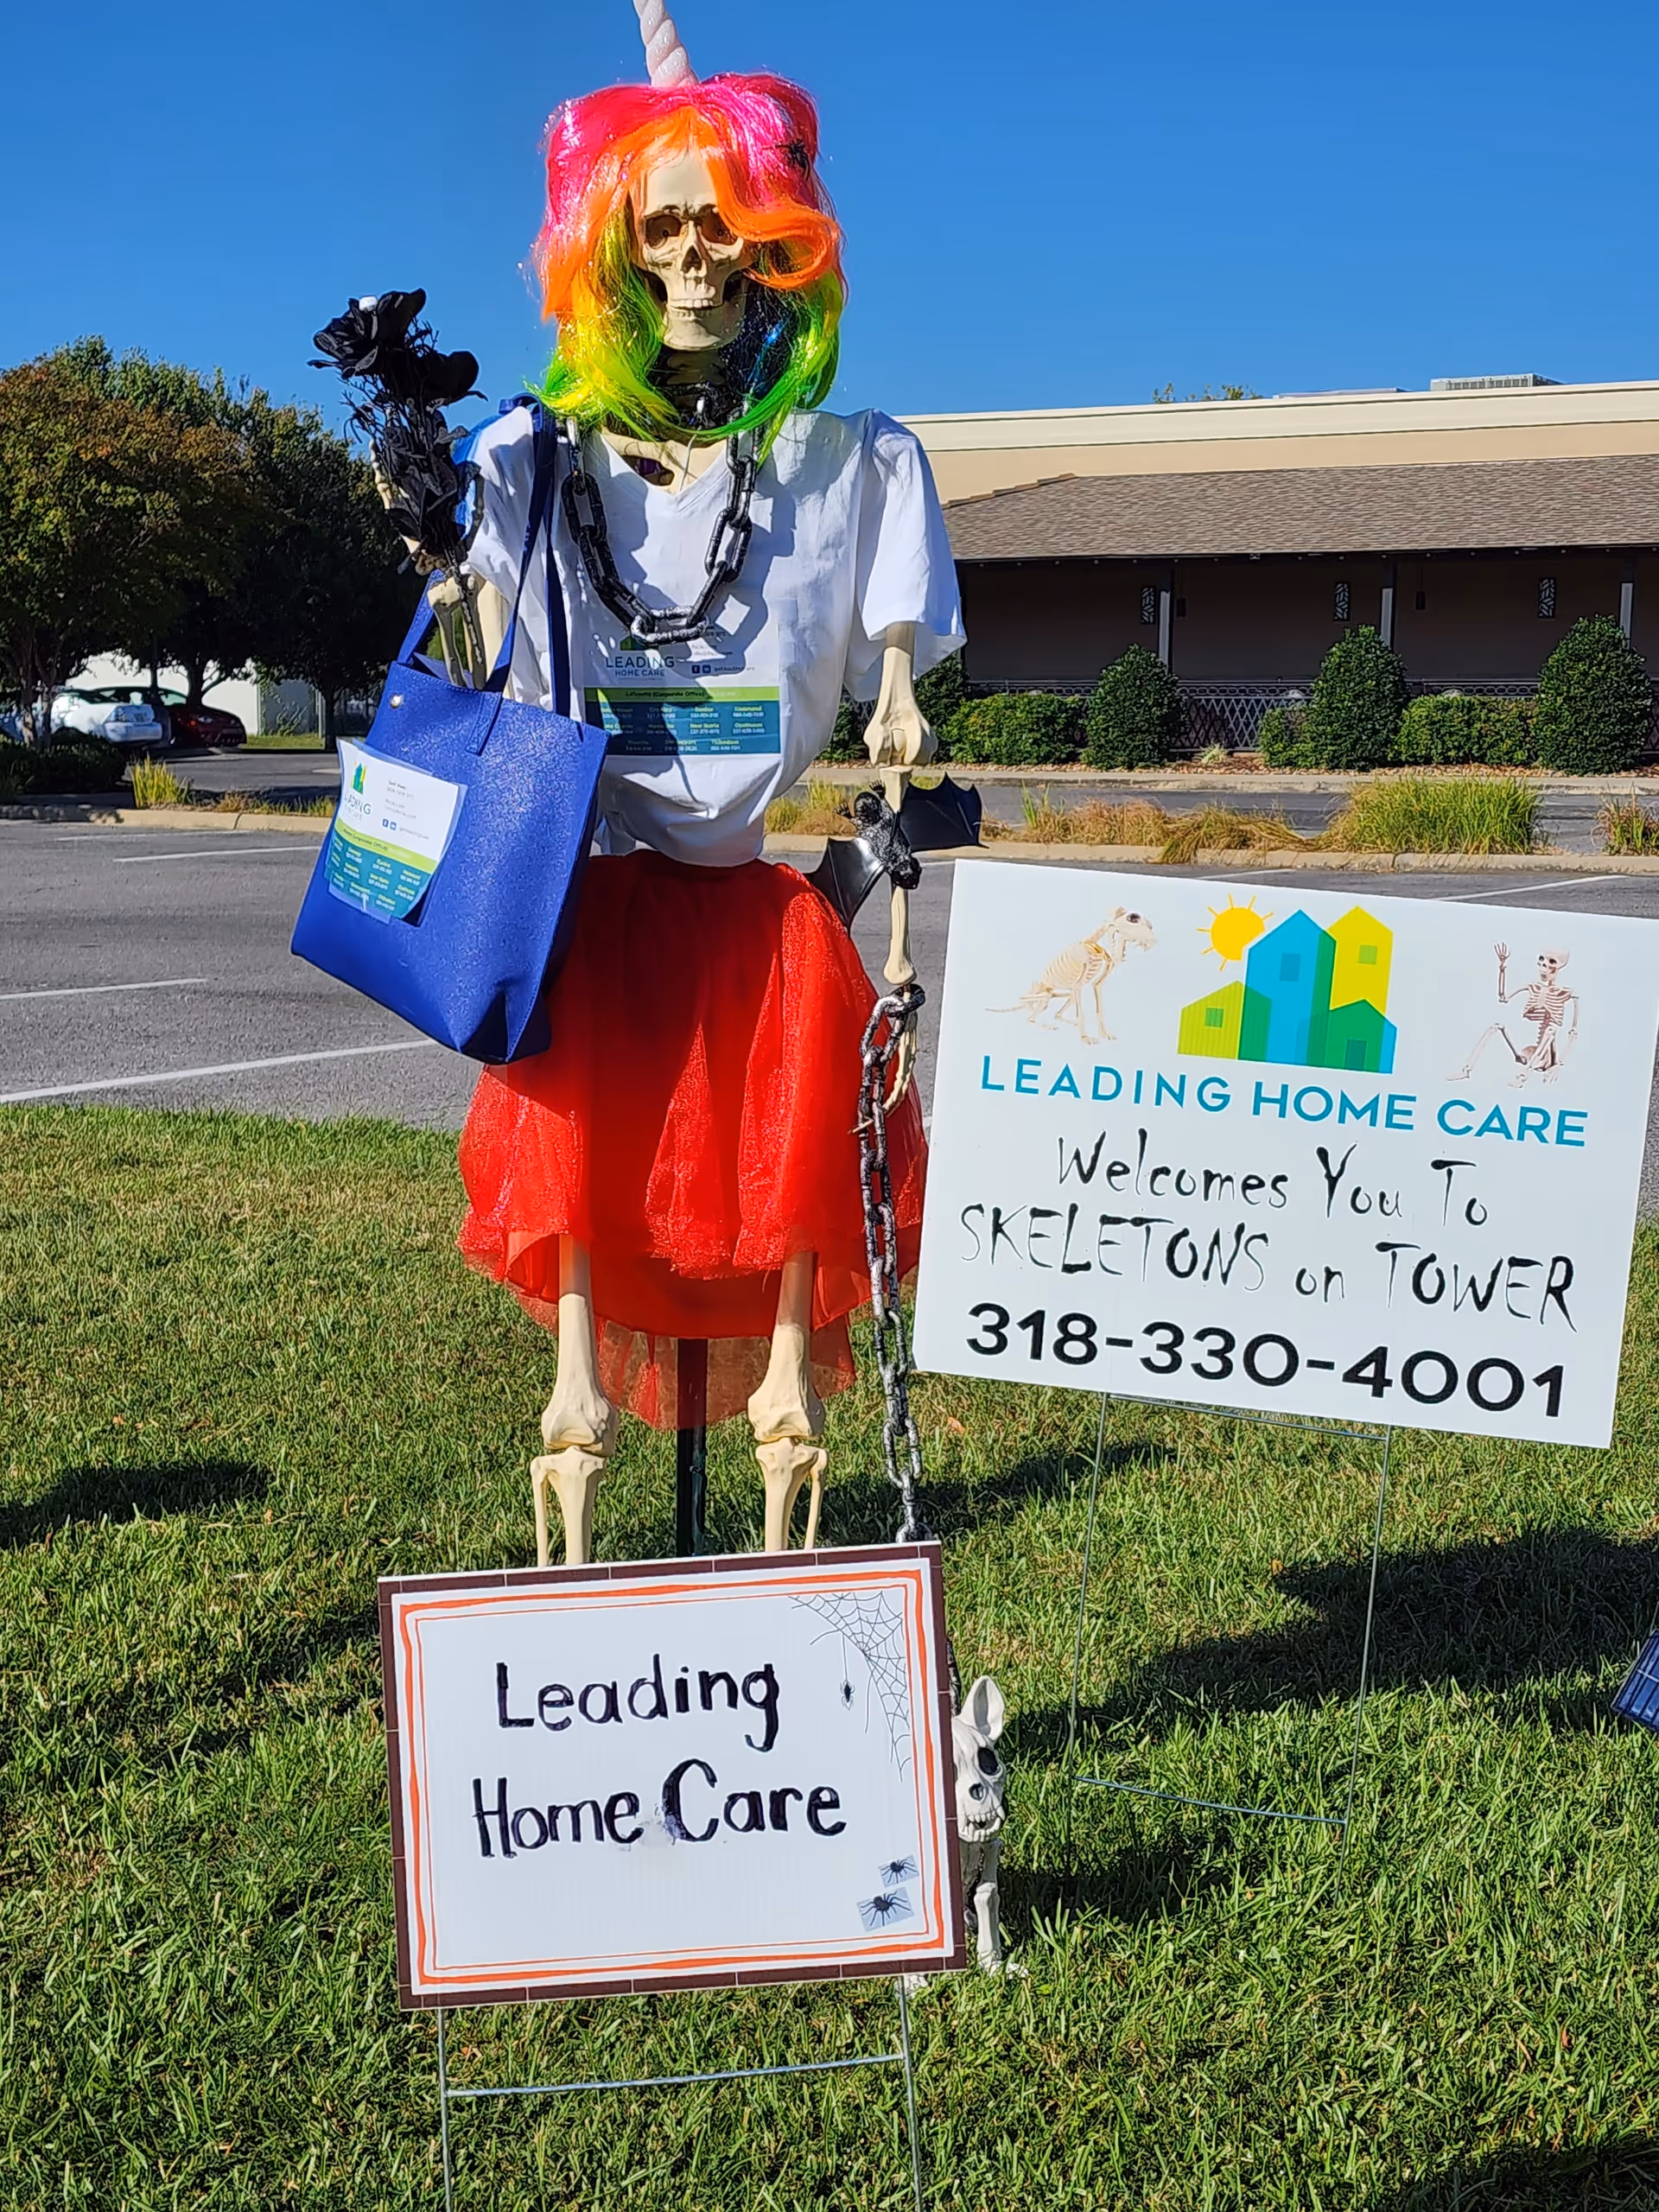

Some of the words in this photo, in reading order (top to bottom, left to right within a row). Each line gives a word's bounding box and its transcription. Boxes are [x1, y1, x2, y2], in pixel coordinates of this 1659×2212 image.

[605, 656, 675, 669] LEADING
[614, 669, 639, 677] HOME
[641, 669, 665, 677] CARE
[981, 1054, 1232, 1113] LEADING
[1251, 1080, 1418, 1131] HOME
[1436, 1098, 1589, 1147] CARE
[1057, 1127, 1289, 1210] Welcomes
[1315, 1142, 1402, 1219] You
[1430, 1158, 1489, 1228] To
[960, 1202, 1269, 1293] SKELETONS
[1294, 1265, 1345, 1304] on
[1375, 1241, 1578, 1333] TOWER
[966, 1301, 1565, 1418] 318-330-4001
[495, 1653, 781, 1753] Leading
[472, 1775, 646, 1859] Home
[661, 1758, 848, 1842] Care
